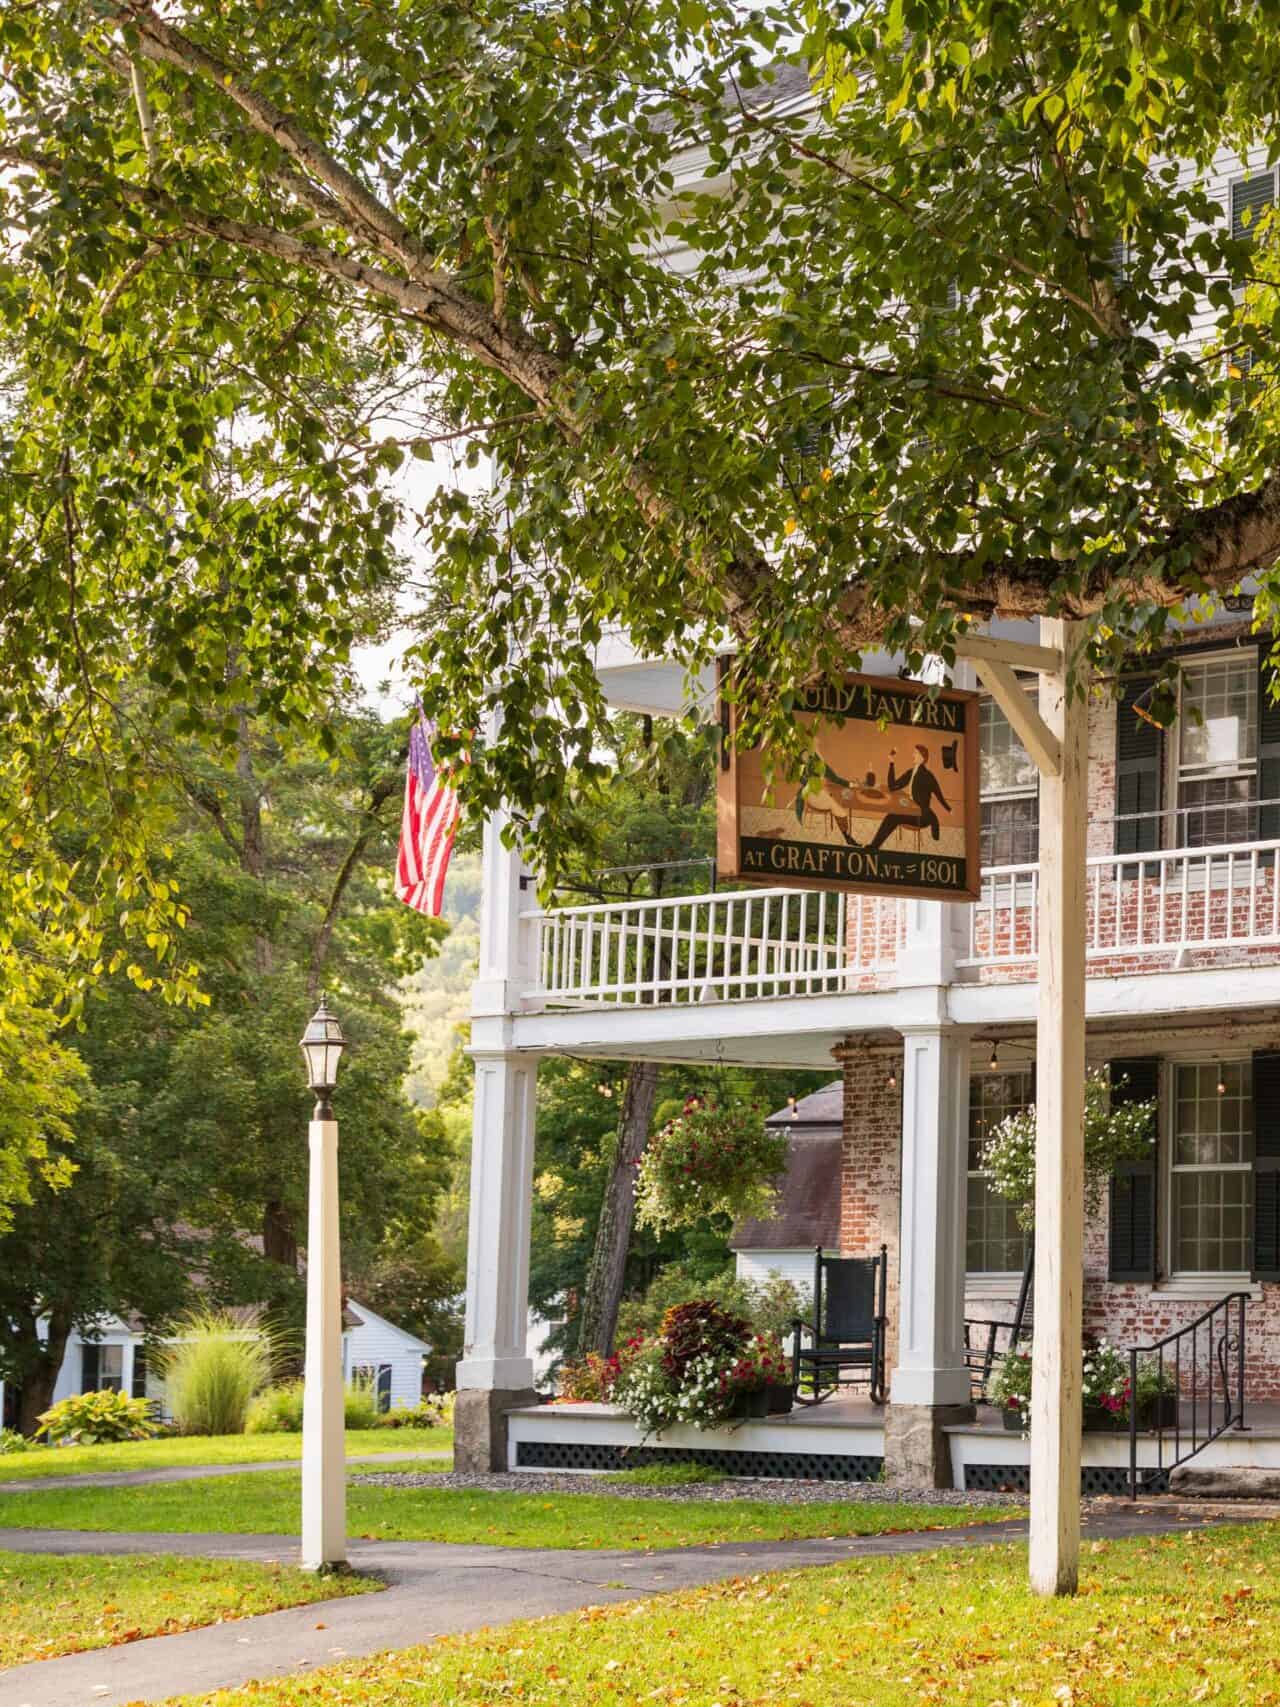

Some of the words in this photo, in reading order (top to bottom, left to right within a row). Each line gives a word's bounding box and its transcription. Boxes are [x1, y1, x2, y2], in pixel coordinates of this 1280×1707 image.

[804, 686, 850, 712] OLD
[865, 693, 957, 727] TAVERN
[745, 849, 765, 866] AT
[919, 859, 960, 885] 1801
